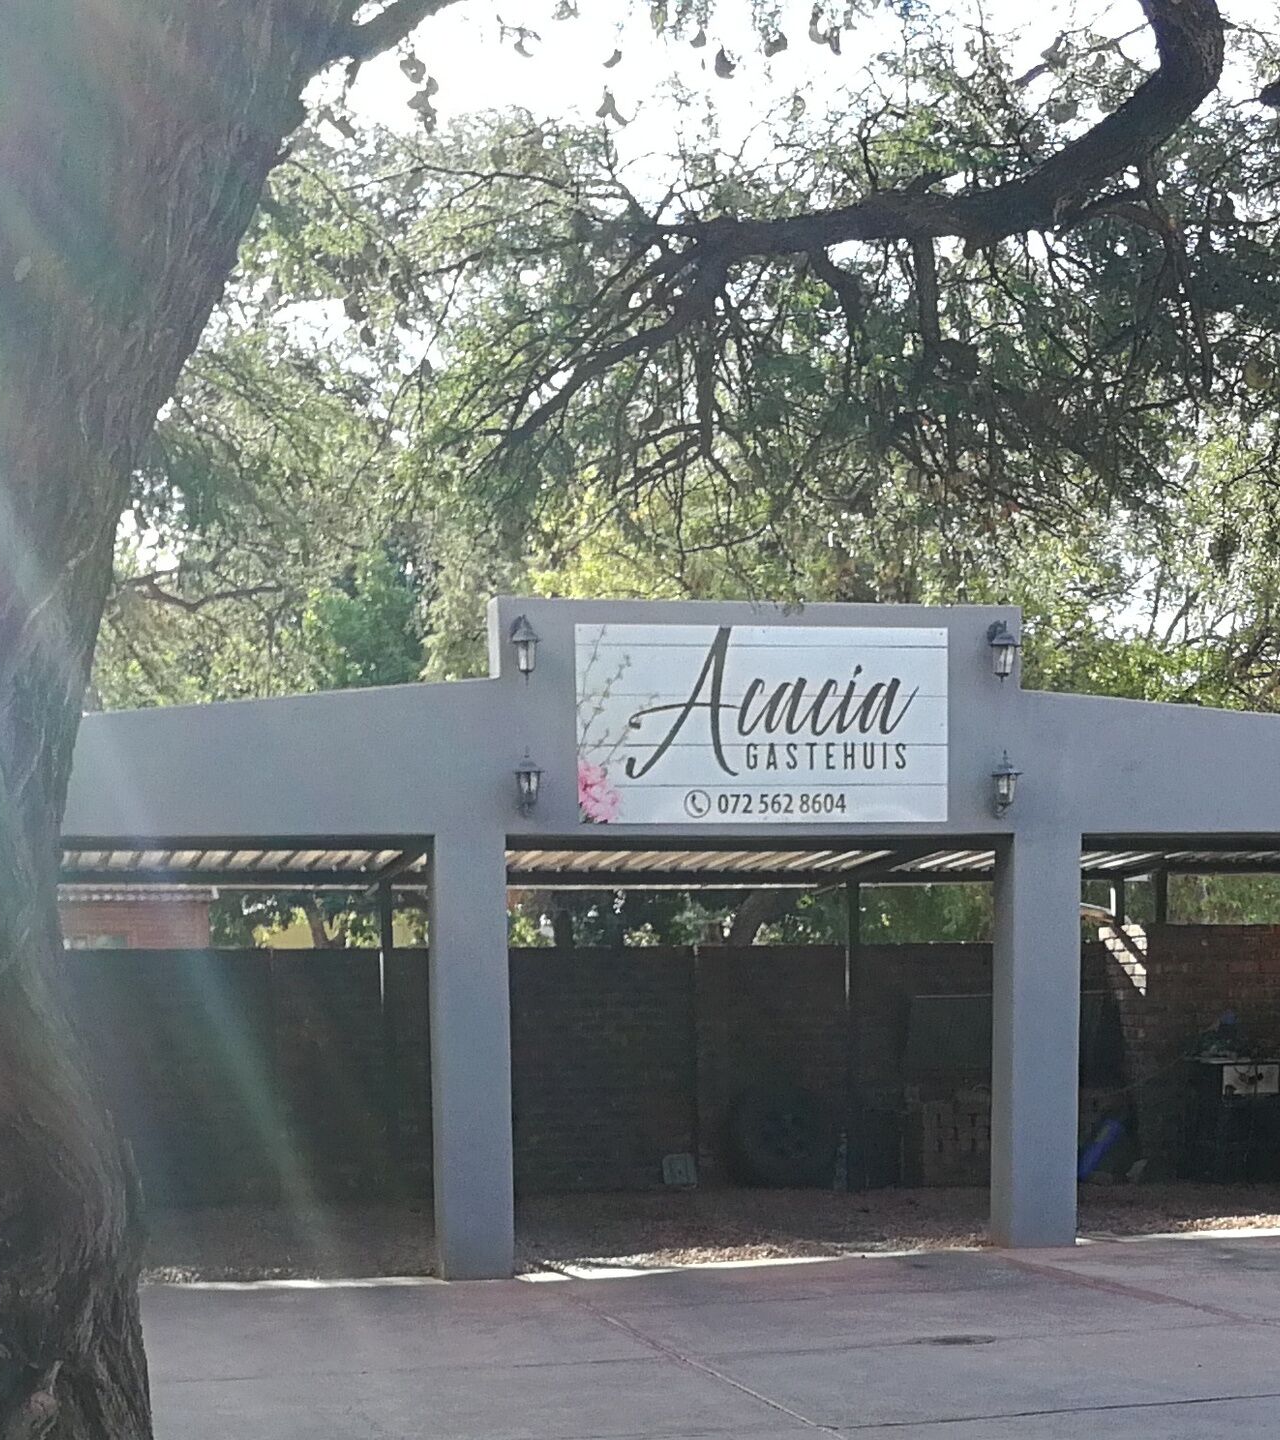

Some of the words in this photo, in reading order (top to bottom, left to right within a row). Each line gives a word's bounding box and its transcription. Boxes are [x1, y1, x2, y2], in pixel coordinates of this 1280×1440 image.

[625, 626, 920, 779] Acacia
[745, 741, 908, 771] GASTEHUIS
[717, 793, 753, 814] 072
[758, 793, 794, 814] 562
[799, 793, 847, 814] 8604
